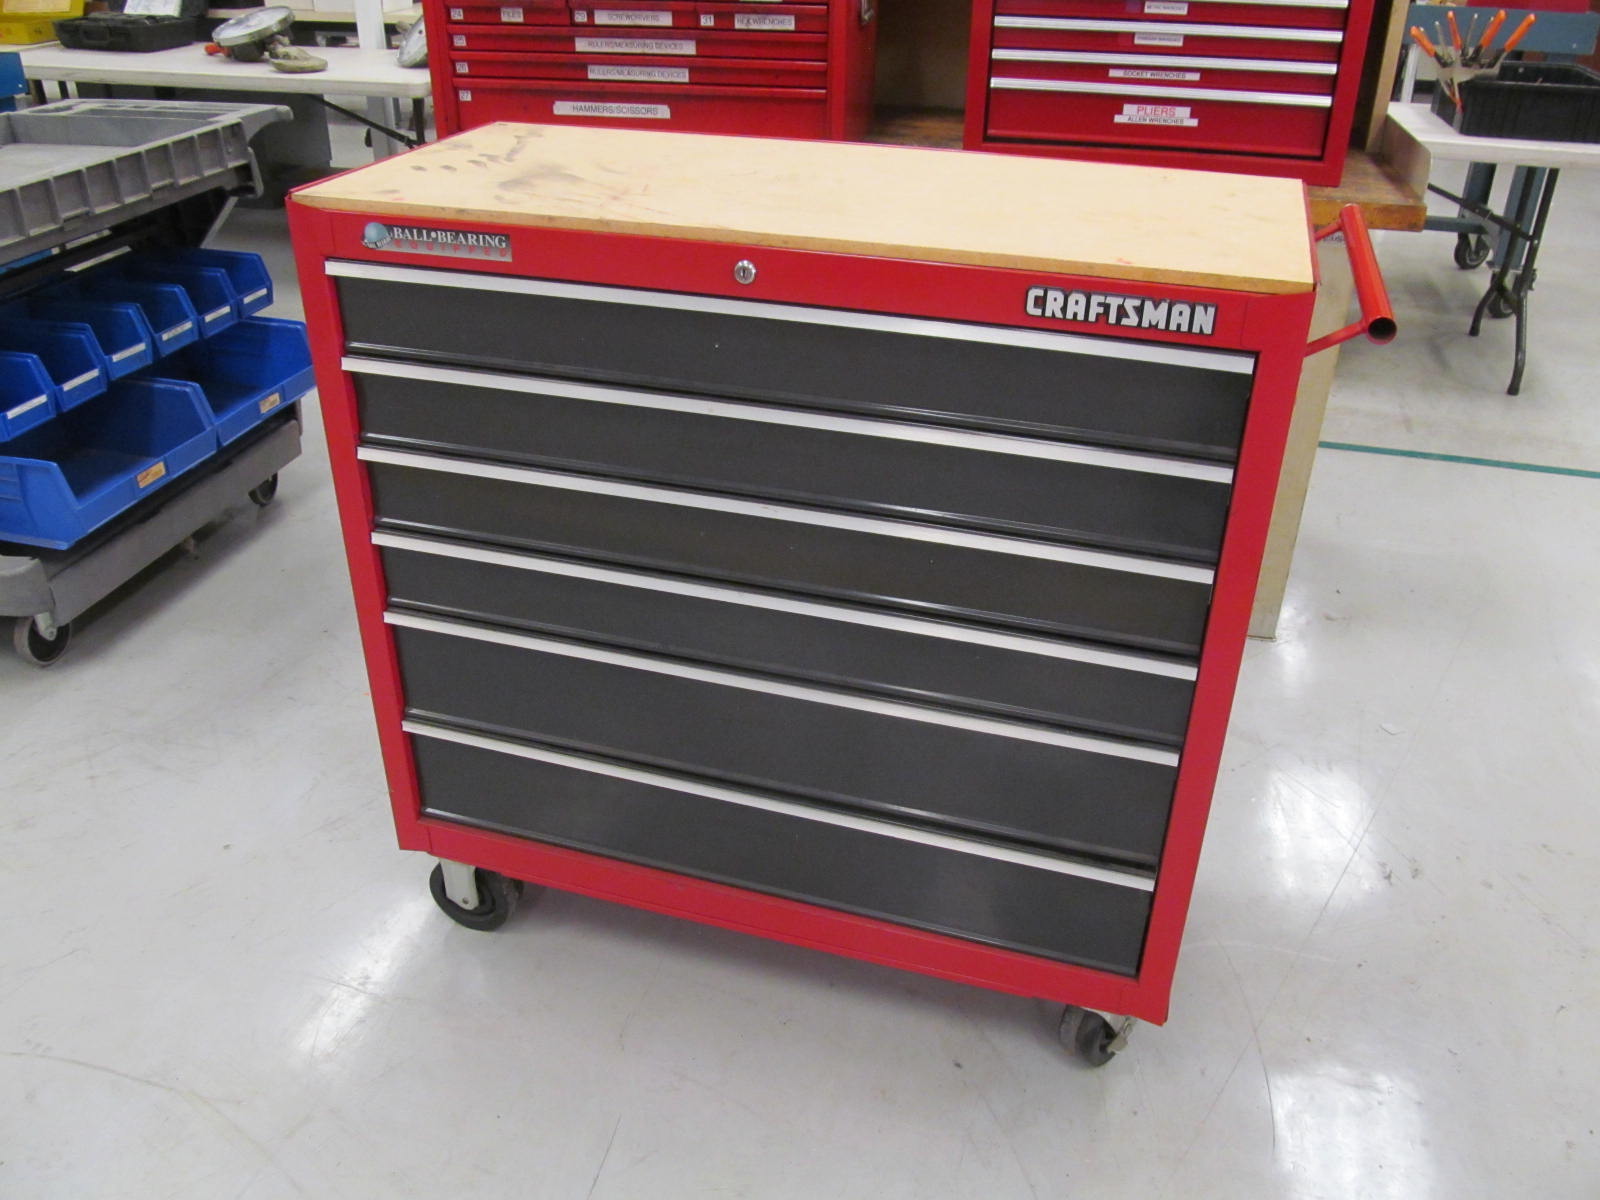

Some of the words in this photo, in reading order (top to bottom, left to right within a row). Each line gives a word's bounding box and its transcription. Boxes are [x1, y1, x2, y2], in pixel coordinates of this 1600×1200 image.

[702, 15, 712, 24] 31
[1150, 71, 1187, 79] WRENCHES
[1136, 105, 1177, 117] PLIERS
[1149, 117, 1184, 125] WRENCHES
[1025, 286, 1217, 335] CRAFTSMAN
